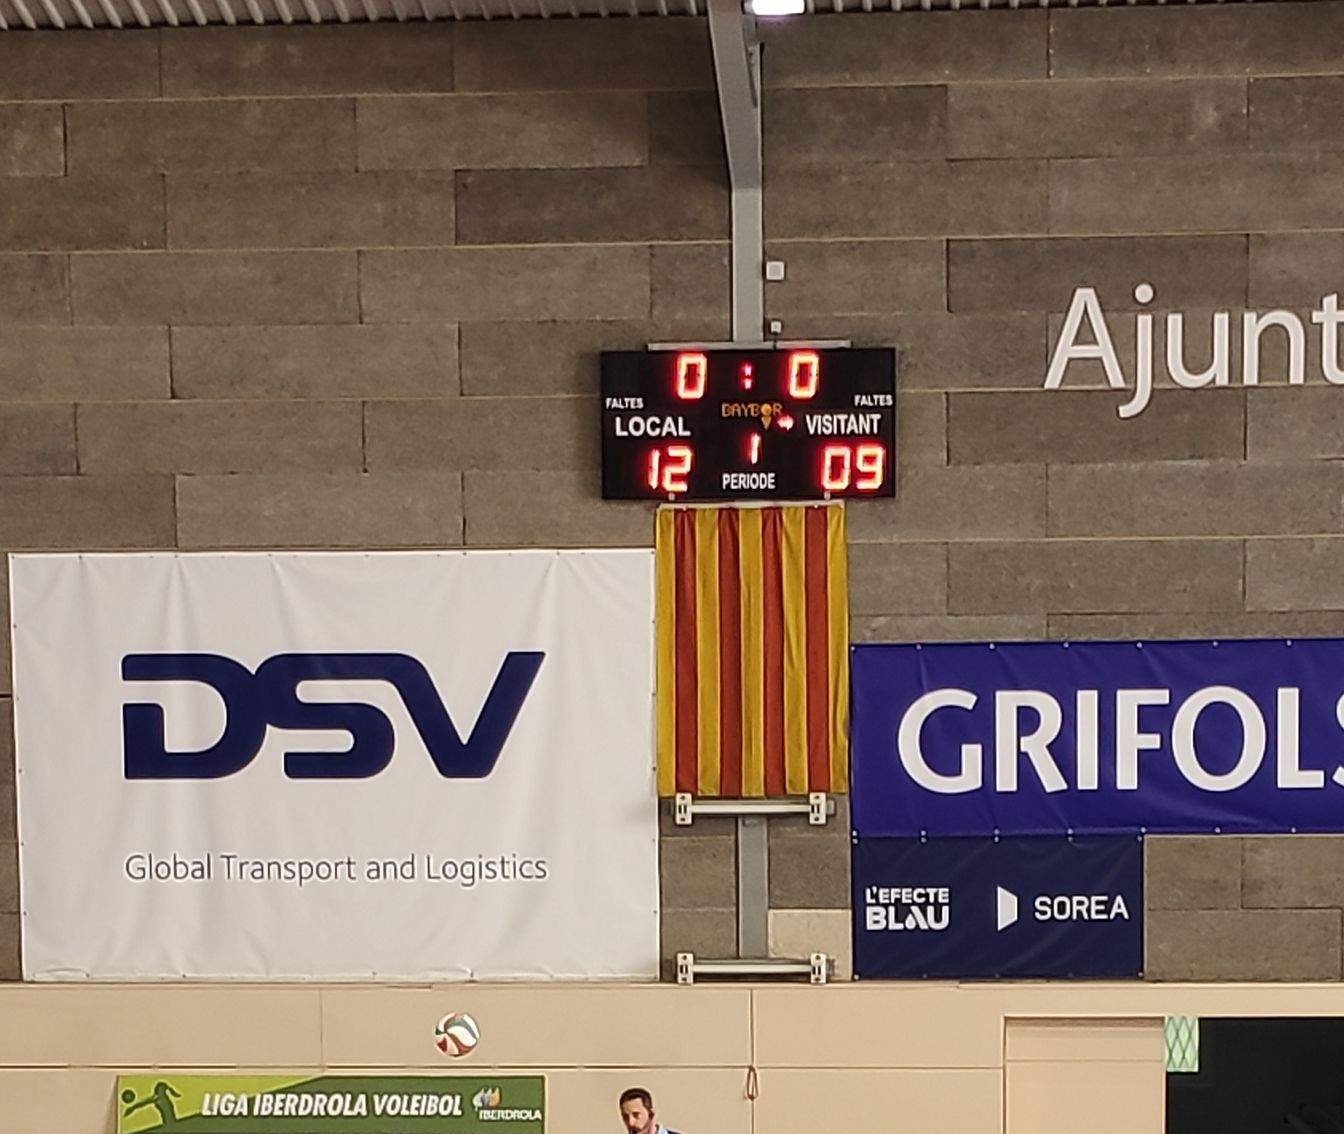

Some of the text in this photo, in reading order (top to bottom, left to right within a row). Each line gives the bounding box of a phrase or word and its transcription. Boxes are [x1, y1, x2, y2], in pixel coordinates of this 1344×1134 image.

[676, 352, 707, 399] 0
[788, 351, 820, 399] 0
[606, 397, 644, 410] FALTES
[854, 393, 893, 407] FALTES
[614, 416, 691, 438] LOCAL
[806, 414, 882, 436] VISITANT
[648, 445, 693, 493] 12
[822, 445, 886, 491] 09
[722, 473, 776, 490] PERIODE
[120, 651, 546, 780] DSV
[124, 852, 548, 888] Global Transport and Logistics
[865, 886, 950, 904] L'EFECTE
[865, 905, 950, 931] BLAU
[1033, 895, 1130, 922] SOREA
[202, 1093, 462, 1117] LIGA IBERDROLA VOLEIBOL
